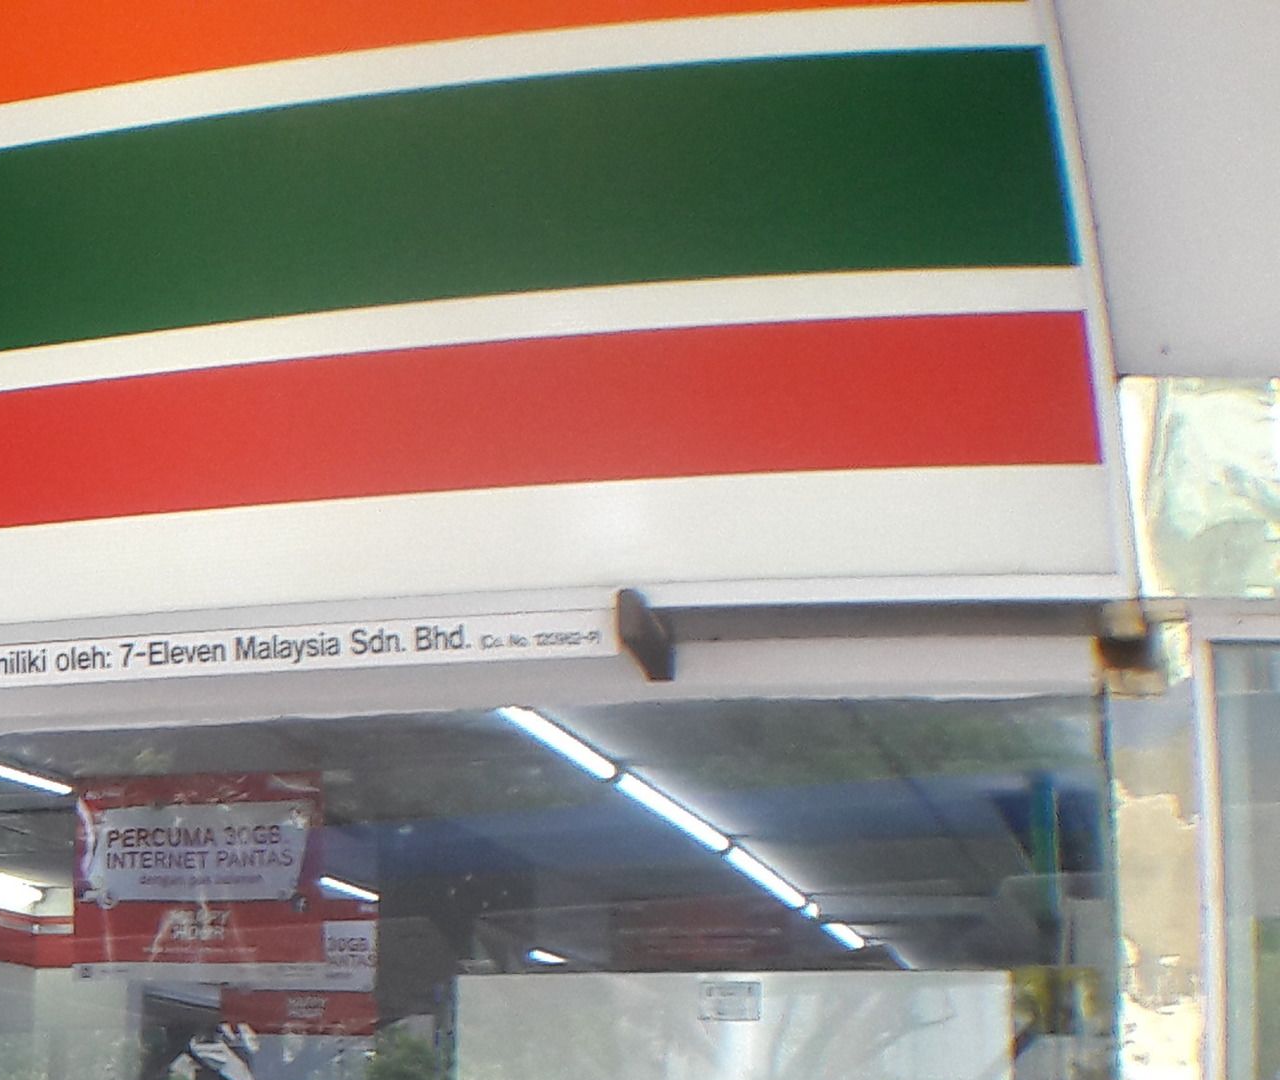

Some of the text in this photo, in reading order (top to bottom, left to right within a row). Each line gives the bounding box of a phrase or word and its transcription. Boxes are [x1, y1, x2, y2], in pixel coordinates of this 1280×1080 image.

[55, 647, 112, 672] oleh:
[120, 641, 227, 668] 7-Eleven
[235, 631, 341, 664] Malaysia
[351, 628, 406, 655] Sdn.
[415, 624, 472, 651] Bhd.
[107, 827, 217, 848] PERCUMA
[107, 849, 294, 869] INTERNET PANTAS
